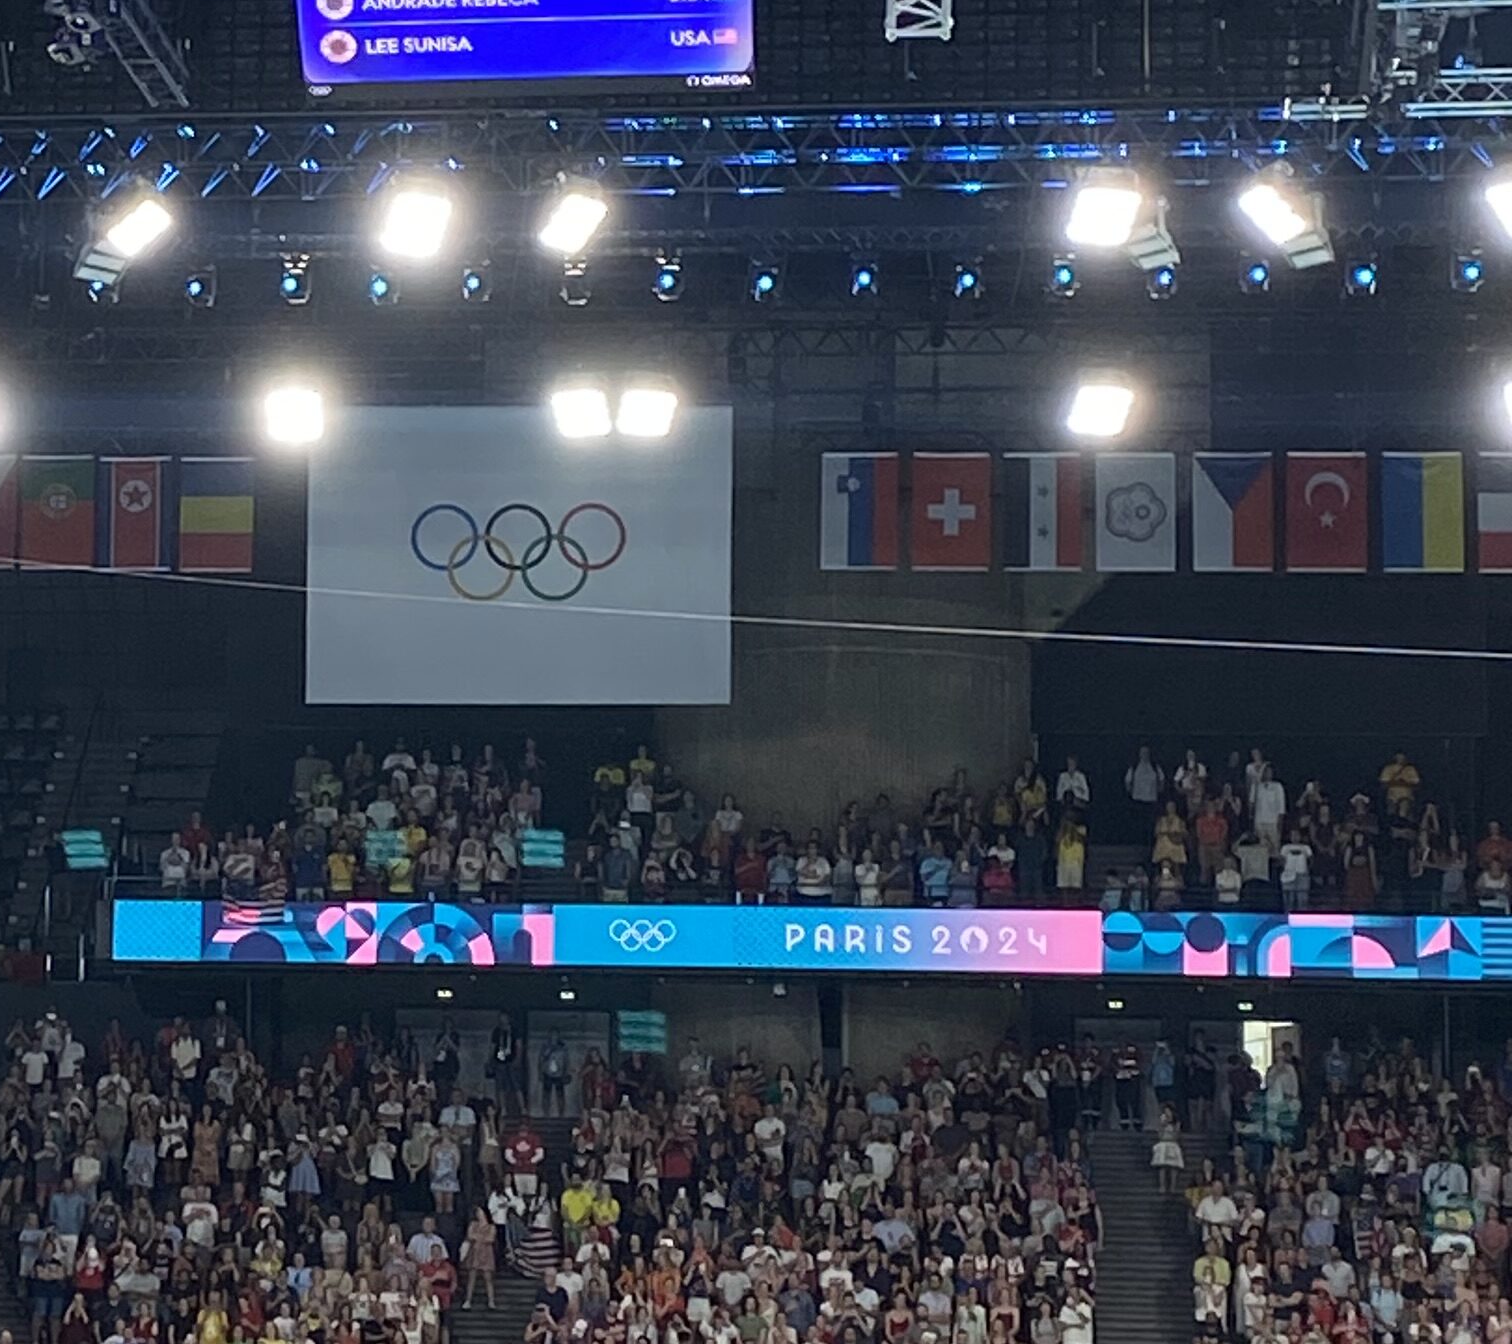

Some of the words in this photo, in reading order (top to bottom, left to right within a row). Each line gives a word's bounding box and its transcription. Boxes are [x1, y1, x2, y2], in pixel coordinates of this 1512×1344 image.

[364, 37, 399, 54] LEE
[403, 36, 473, 54] SUNISA
[670, 29, 710, 46] USA
[785, 923, 913, 954] PARIS
[931, 925, 1048, 955] 2024
